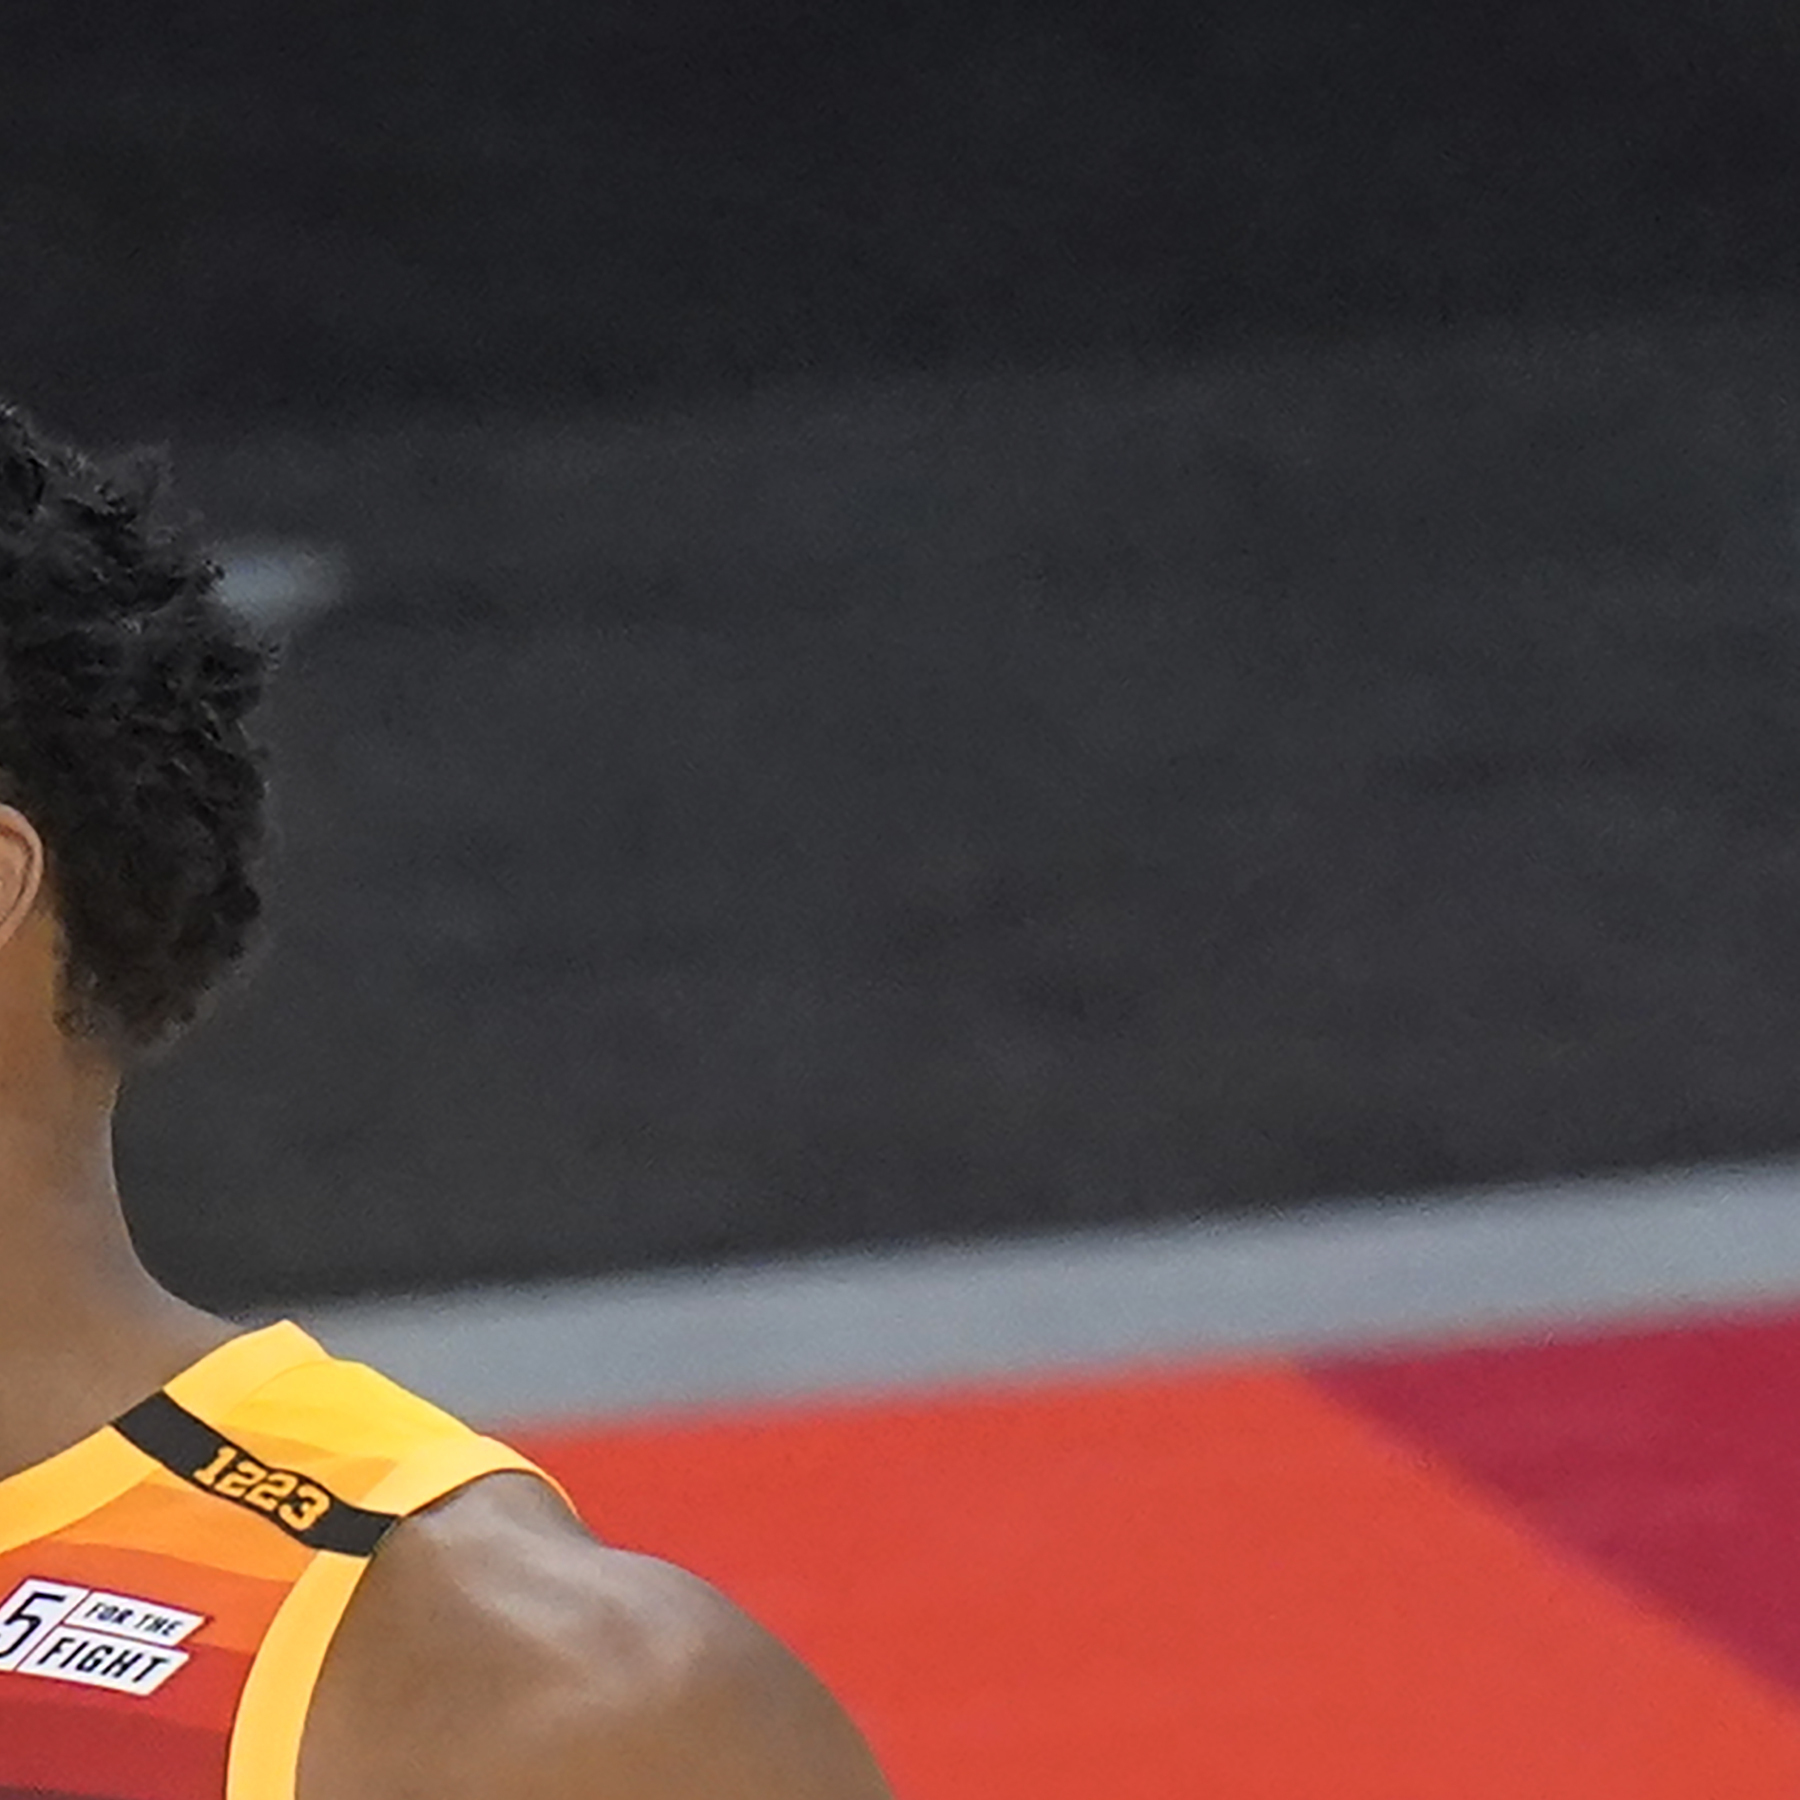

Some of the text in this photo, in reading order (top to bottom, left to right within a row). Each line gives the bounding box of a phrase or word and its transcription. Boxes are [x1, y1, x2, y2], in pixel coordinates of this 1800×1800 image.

[193, 1445, 331, 1531] 1223
[83, 1602, 183, 1637] FOR THE
[36, 1637, 169, 1684] FIGHT
